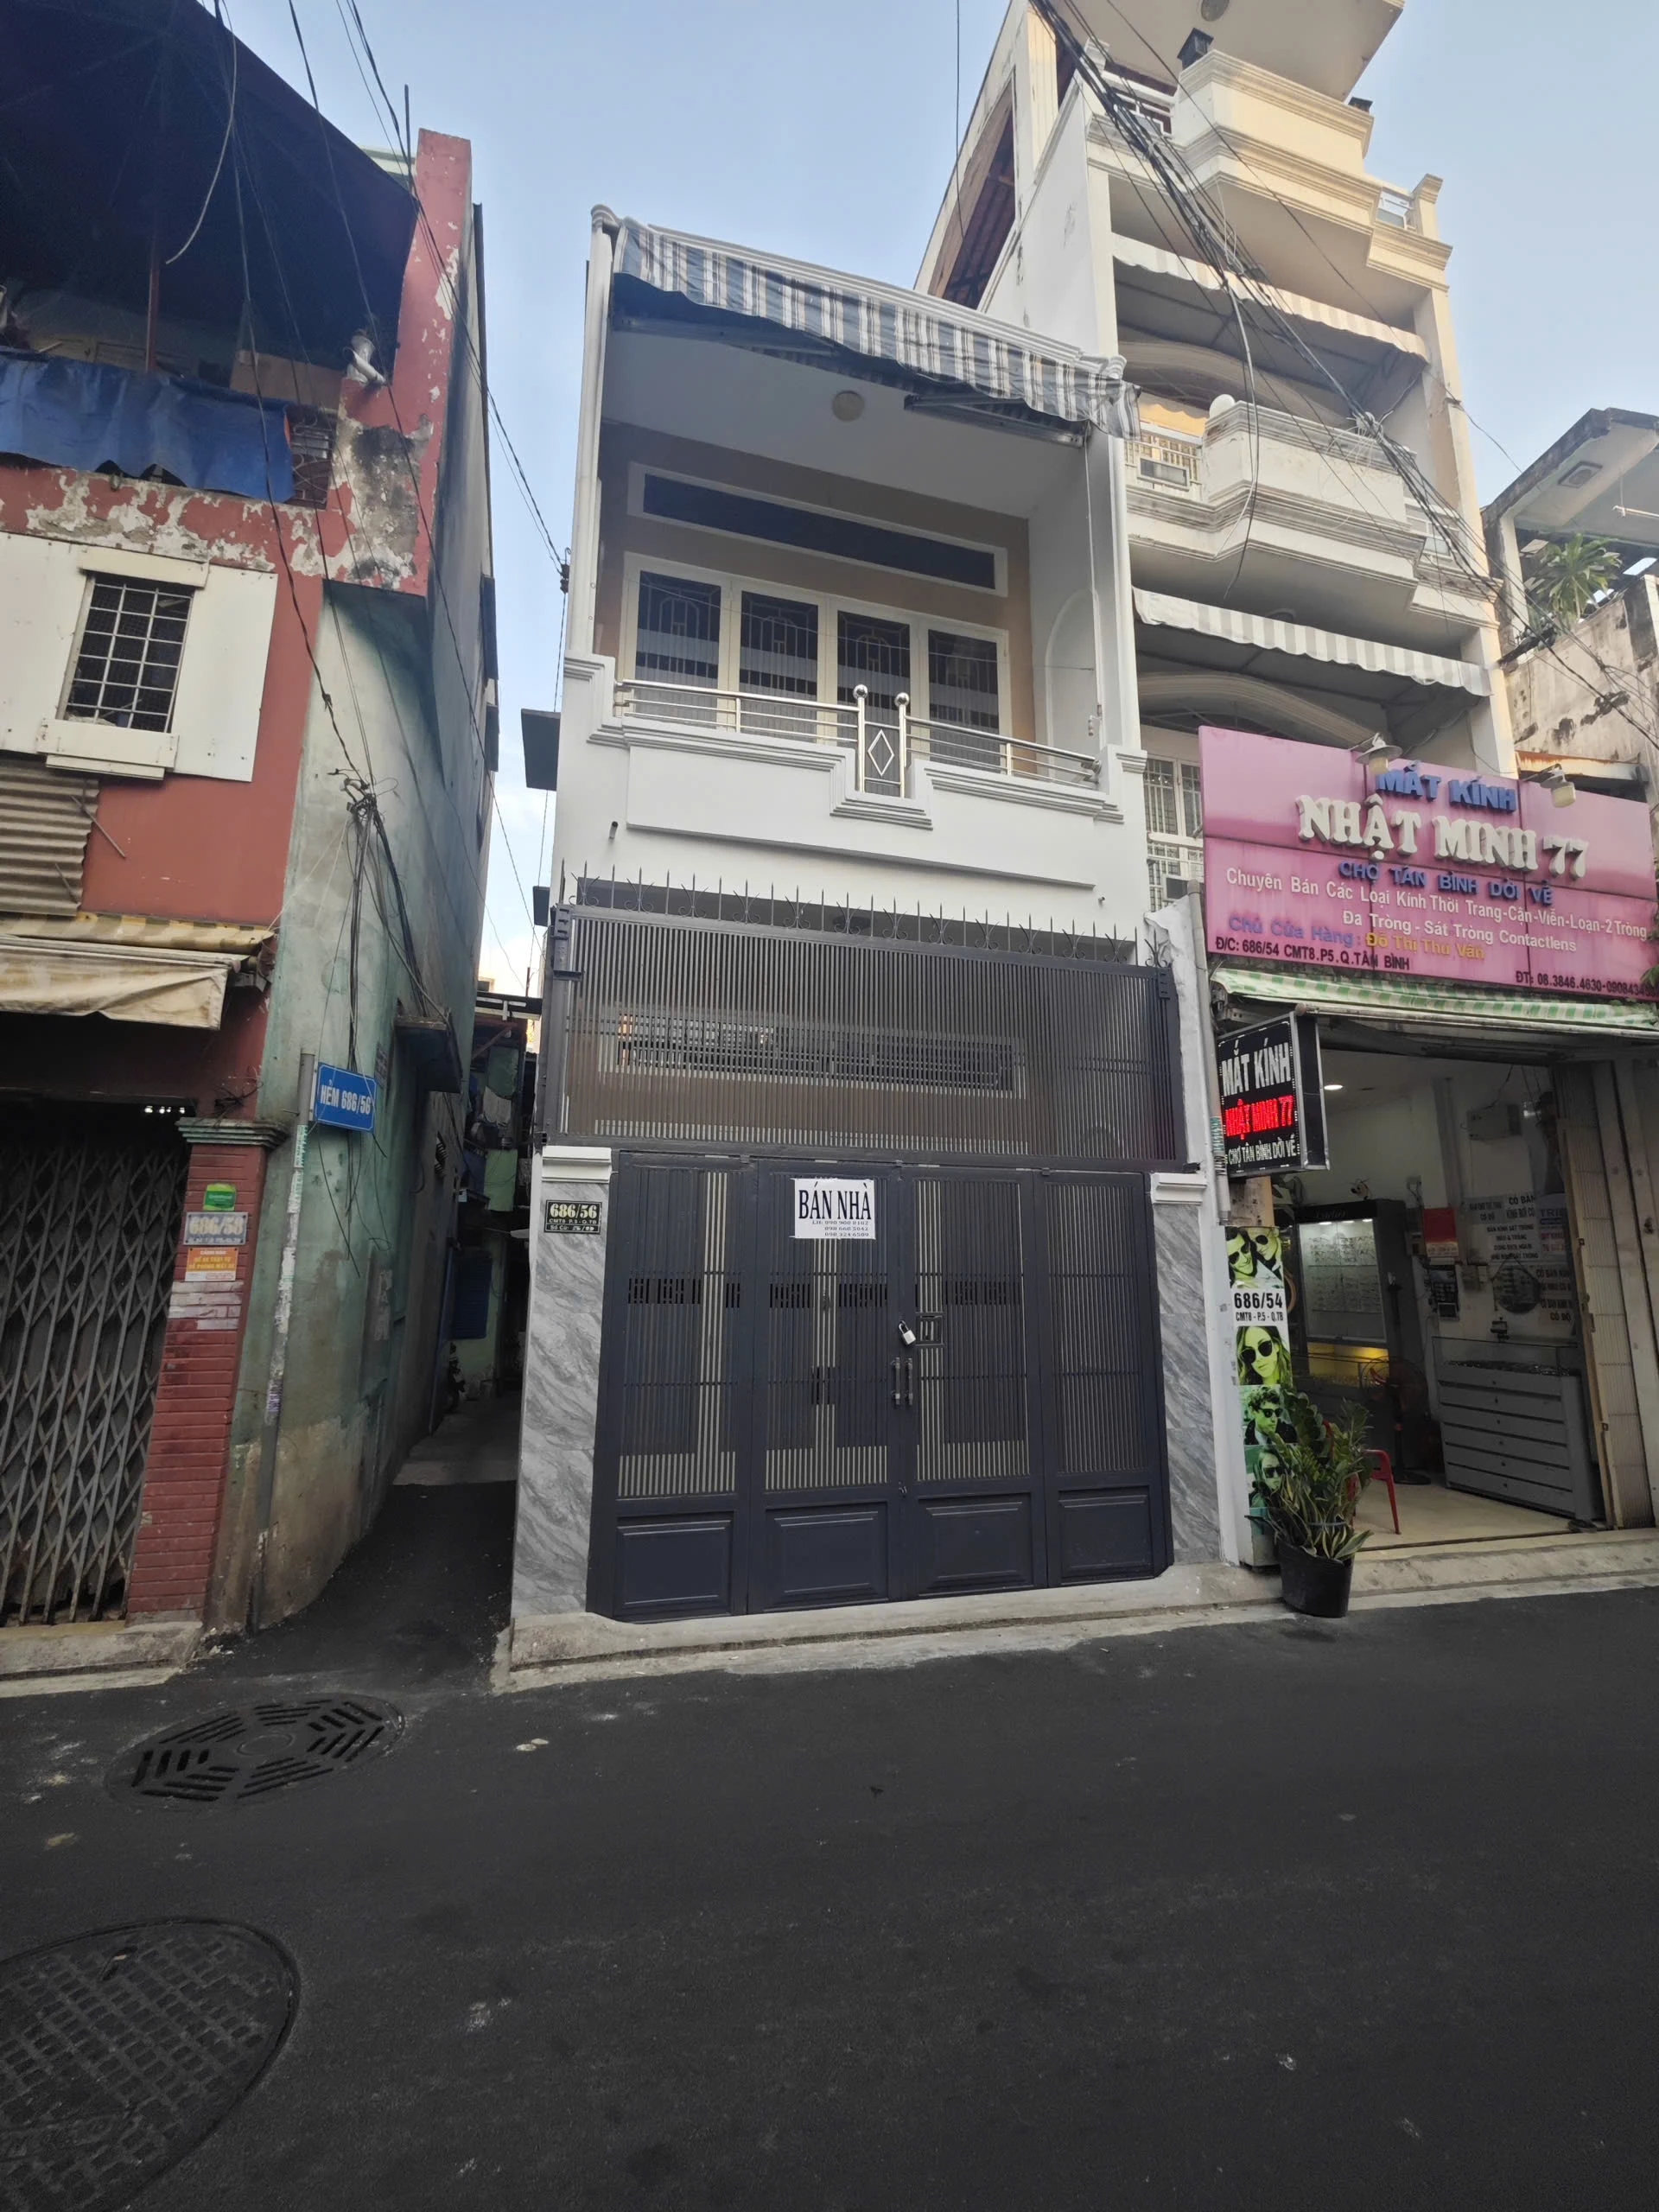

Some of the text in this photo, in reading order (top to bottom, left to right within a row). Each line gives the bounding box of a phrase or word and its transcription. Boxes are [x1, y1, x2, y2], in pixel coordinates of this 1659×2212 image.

[1375, 760, 1517, 813] MẮT KÍNH
[1295, 794, 1590, 880] NHẬT MINH 77
[1227, 868, 1282, 893] Chuyên
[1291, 876, 1319, 895] Bán
[1326, 881, 1353, 899] Các
[1361, 887, 1390, 908] Loại
[1396, 890, 1427, 909] Kính
[1430, 894, 1459, 913] Thời
[1343, 910, 1363, 926] Đa
[1370, 913, 1411, 935] Tròng
[1425, 920, 1448, 938] Sát
[1453, 923, 1494, 945] Tròng
[1499, 930, 1577, 952] Contactlens
[1215, 937, 1239, 952] Đ/C:
[1242, 938, 1280, 957] 686/54
[1384, 950, 1410, 970] BÌNH
[1222, 1038, 1292, 1096] MẮT KÍNH
[320, 1078, 372, 1115] HẺM 686/56
[1225, 1098, 1250, 1141] NHẬT
[1278, 1095, 1294, 1127] 77
[550, 1203, 597, 1218] 686/56
[798, 1180, 871, 1220] BÁN NHÀ
[1234, 1292, 1283, 1309] 686/54
[1236, 1312, 1252, 1322] CMT8
